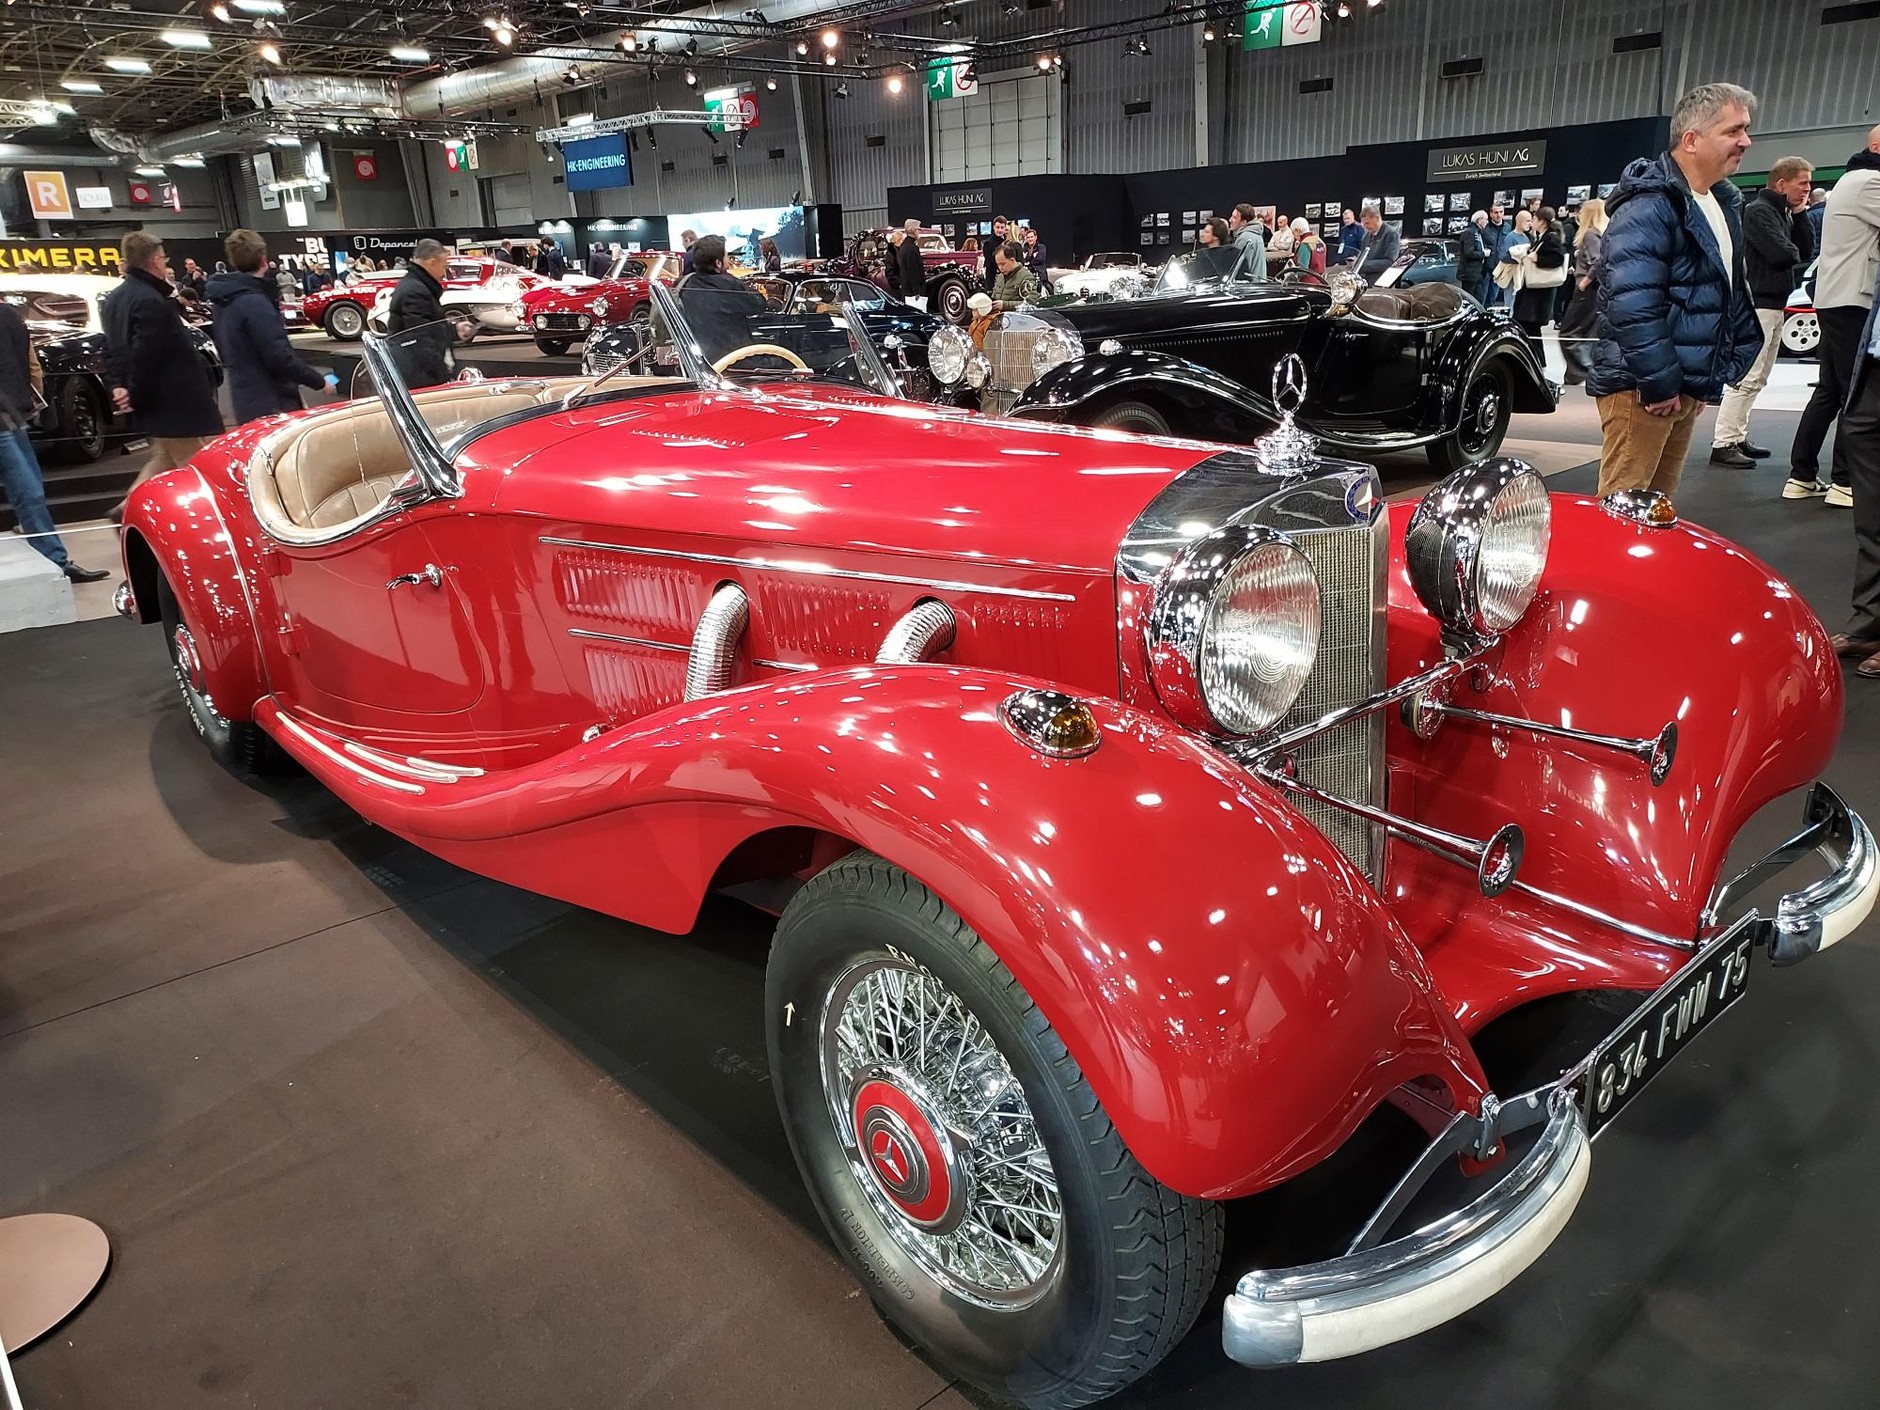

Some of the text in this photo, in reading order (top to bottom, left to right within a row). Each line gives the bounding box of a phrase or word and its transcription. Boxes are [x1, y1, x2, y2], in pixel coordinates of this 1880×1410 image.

[567, 154, 626, 172] HK-ENGINEERING
[1442, 147, 1529, 168] LUKAS HUNI AG
[35, 181, 61, 207] R
[939, 195, 957, 205] LUKAS
[975, 193, 984, 203] AG
[369, 237, 418, 251] Depancel
[1597, 938, 1751, 1114] 834 FWW 75
